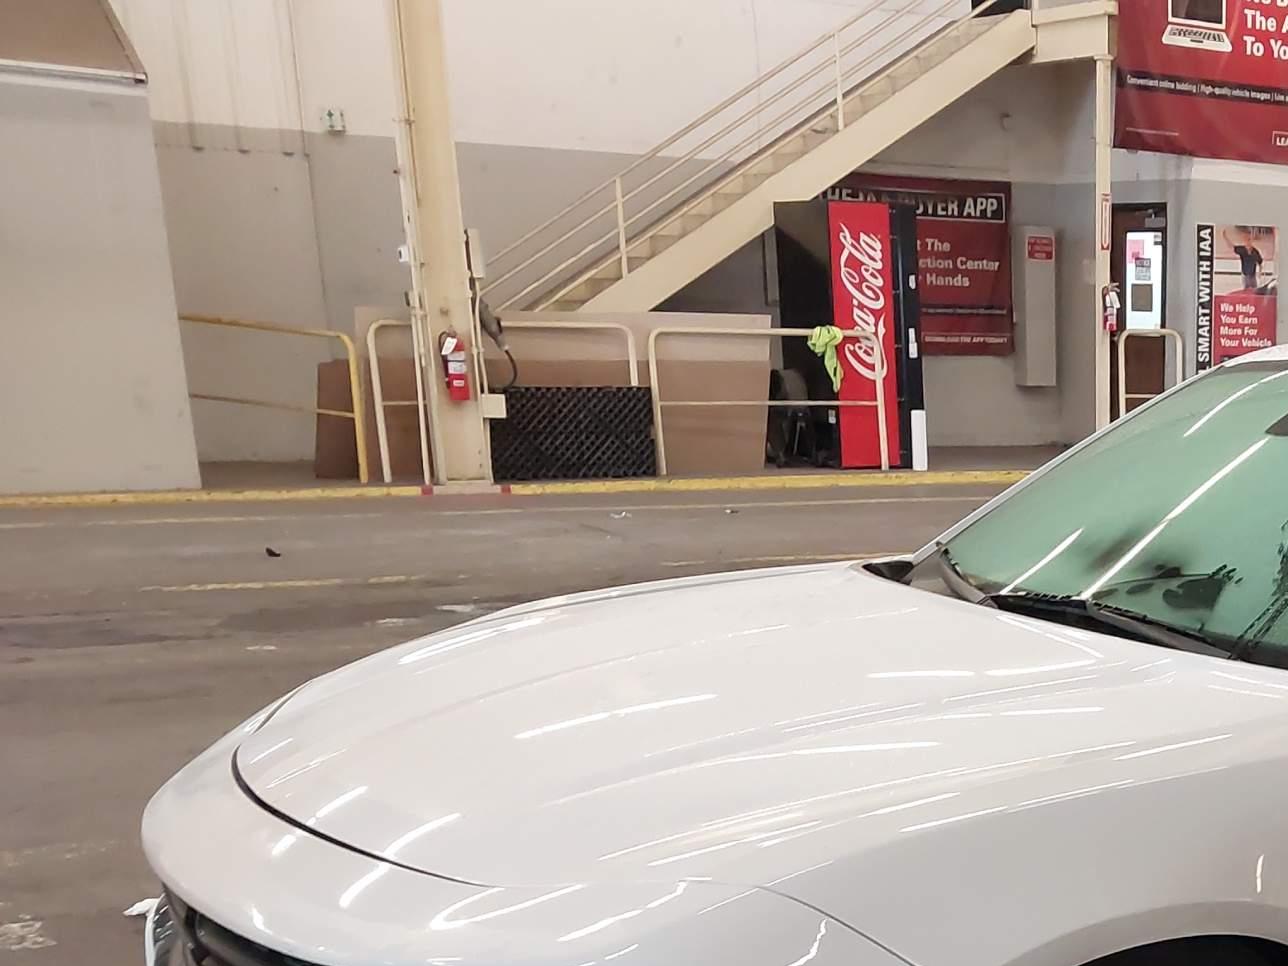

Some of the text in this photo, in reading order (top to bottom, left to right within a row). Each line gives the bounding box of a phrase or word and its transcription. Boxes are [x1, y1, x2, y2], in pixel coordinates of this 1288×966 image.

[1244, 9, 1276, 32] The
[1243, 36, 1265, 56] To
[963, 197, 998, 218] APP
[925, 238, 950, 252] The
[1199, 228, 1212, 256] IAA
[918, 256, 1000, 271] ction Center
[926, 274, 970, 287] Hands
[1199, 261, 1211, 303] WITH
[839, 222, 888, 381] Coca-Cola
[1220, 303, 1255, 315] We Help
[1220, 315, 1258, 324] You Earn
[1198, 306, 1211, 362] SMART
[1220, 326, 1257, 336] More For
[1220, 338, 1272, 347] Your Vehicle
